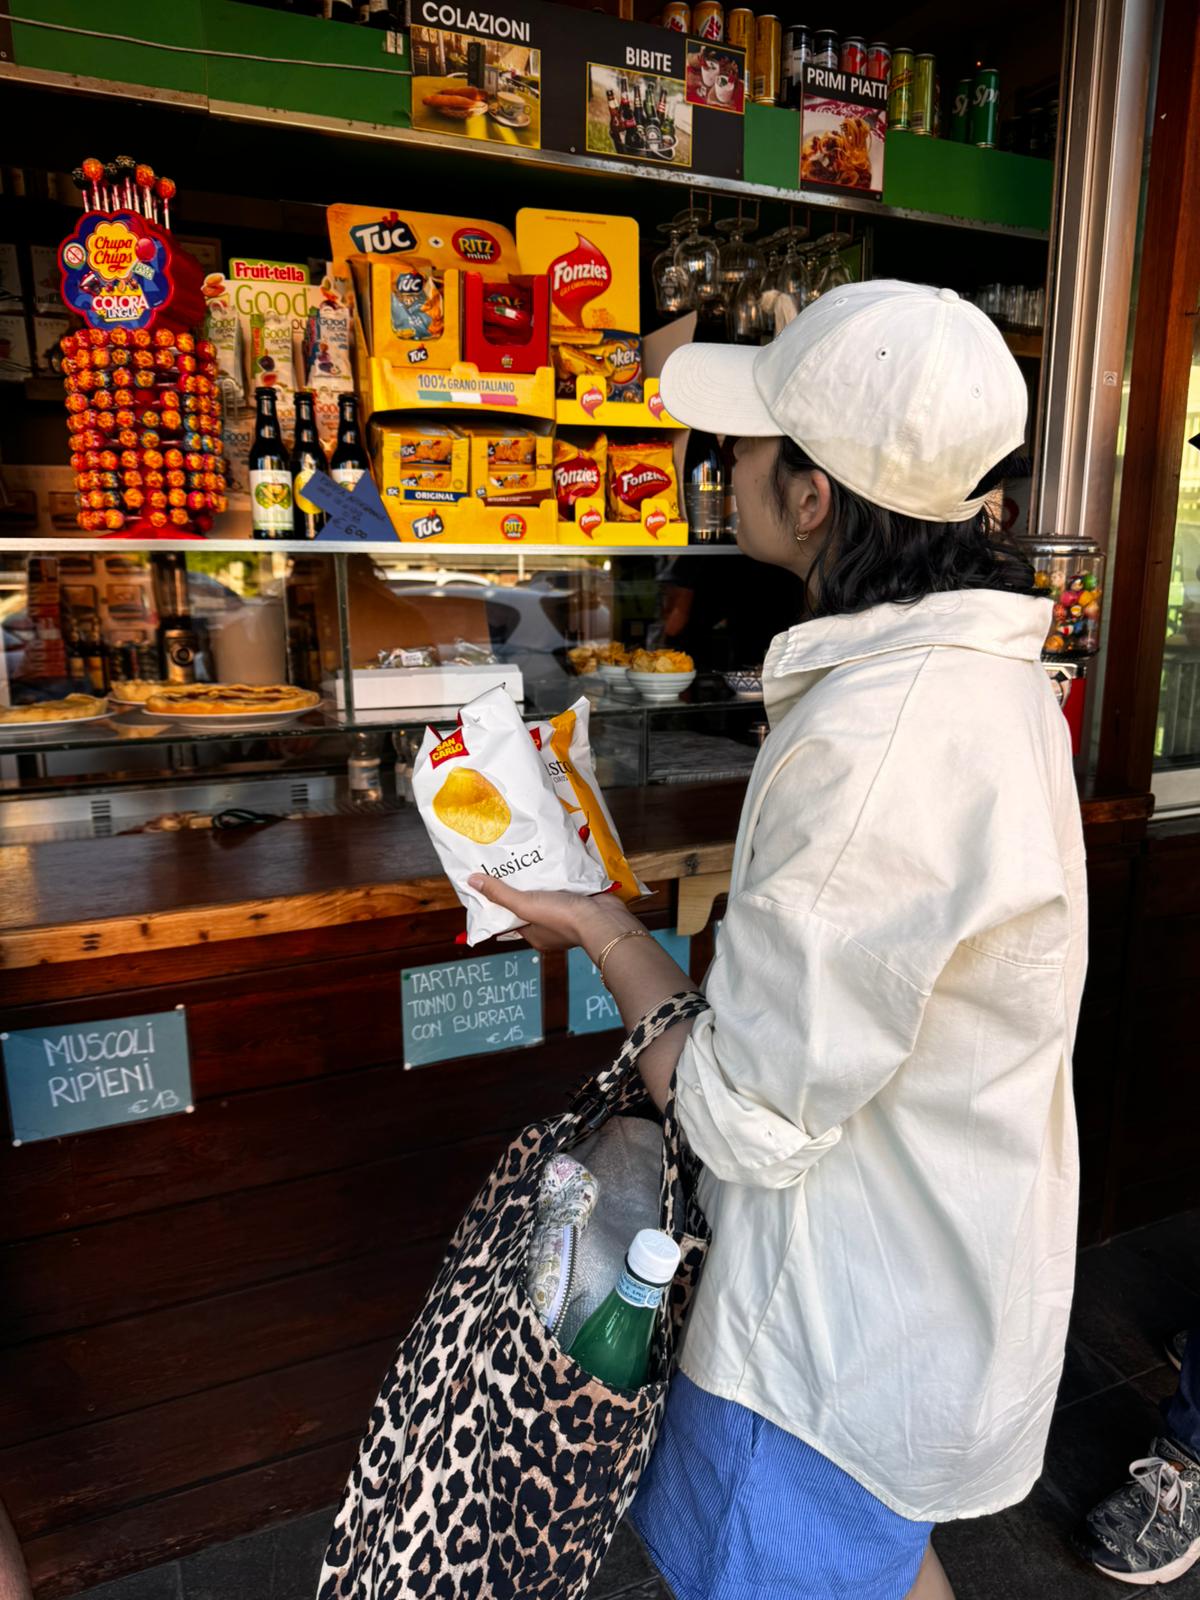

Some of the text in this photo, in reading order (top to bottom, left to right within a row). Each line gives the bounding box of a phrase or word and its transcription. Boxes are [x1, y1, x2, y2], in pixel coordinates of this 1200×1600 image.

[422, 2, 531, 42] COLAZIONI
[625, 46, 673, 73] BIBITE
[806, 66, 847, 91] PRIMI
[851, 78, 888, 101] PIATTI
[94, 236, 133, 252] Chupa
[355, 225, 411, 253] TUC
[458, 237, 494, 254] RITZ
[94, 251, 133, 270] Chups
[232, 262, 306, 282] Fruit-tella
[554, 259, 608, 291] Fonzies
[92, 295, 150, 309] COLORA
[235, 284, 308, 317] Good
[409, 349, 427, 362] TUC
[417, 374, 516, 393] 100% GRANO ITALIANO
[554, 467, 598, 486] Fonzies
[415, 491, 455, 501] ORIGINAL
[414, 518, 442, 538] TUC
[432, 743, 463, 761] CARLO
[436, 737, 456, 751] SAN
[481, 845, 544, 879] lassica
[410, 962, 493, 994] TARTARE
[407, 977, 538, 1019] TONNO O SALMONE
[411, 1005, 526, 1041] CON BURRATA
[503, 1026, 524, 1043] 15
[43, 1022, 156, 1067] MUSCOLI
[48, 1057, 155, 1108] RIPIENI
[128, 1088, 180, 1114] € 13
